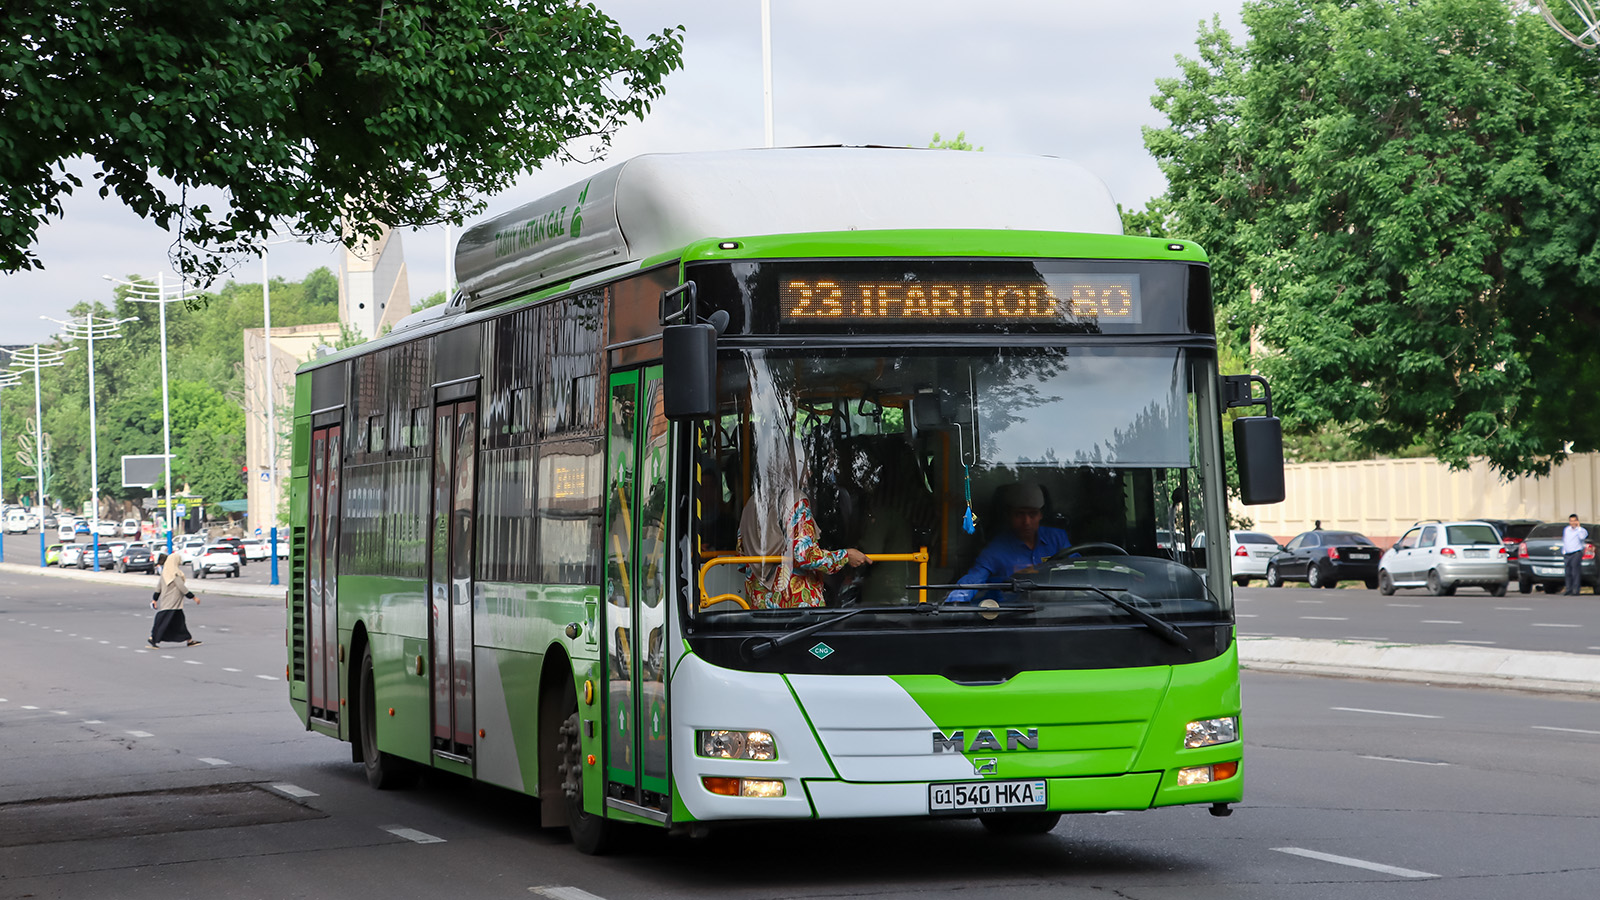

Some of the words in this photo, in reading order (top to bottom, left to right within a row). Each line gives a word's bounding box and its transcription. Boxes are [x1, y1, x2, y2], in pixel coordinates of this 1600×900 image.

[518, 214, 547, 251] METAN
[547, 205, 567, 239] GAZ
[788, 281, 842, 316] 23
[1072, 285, 1131, 316] BO
[932, 728, 1039, 753] MAN
[935, 789, 953, 804] 01
[955, 785, 990, 806] 540
[995, 783, 1034, 804] HKA
[1035, 795, 1044, 803] UZ
